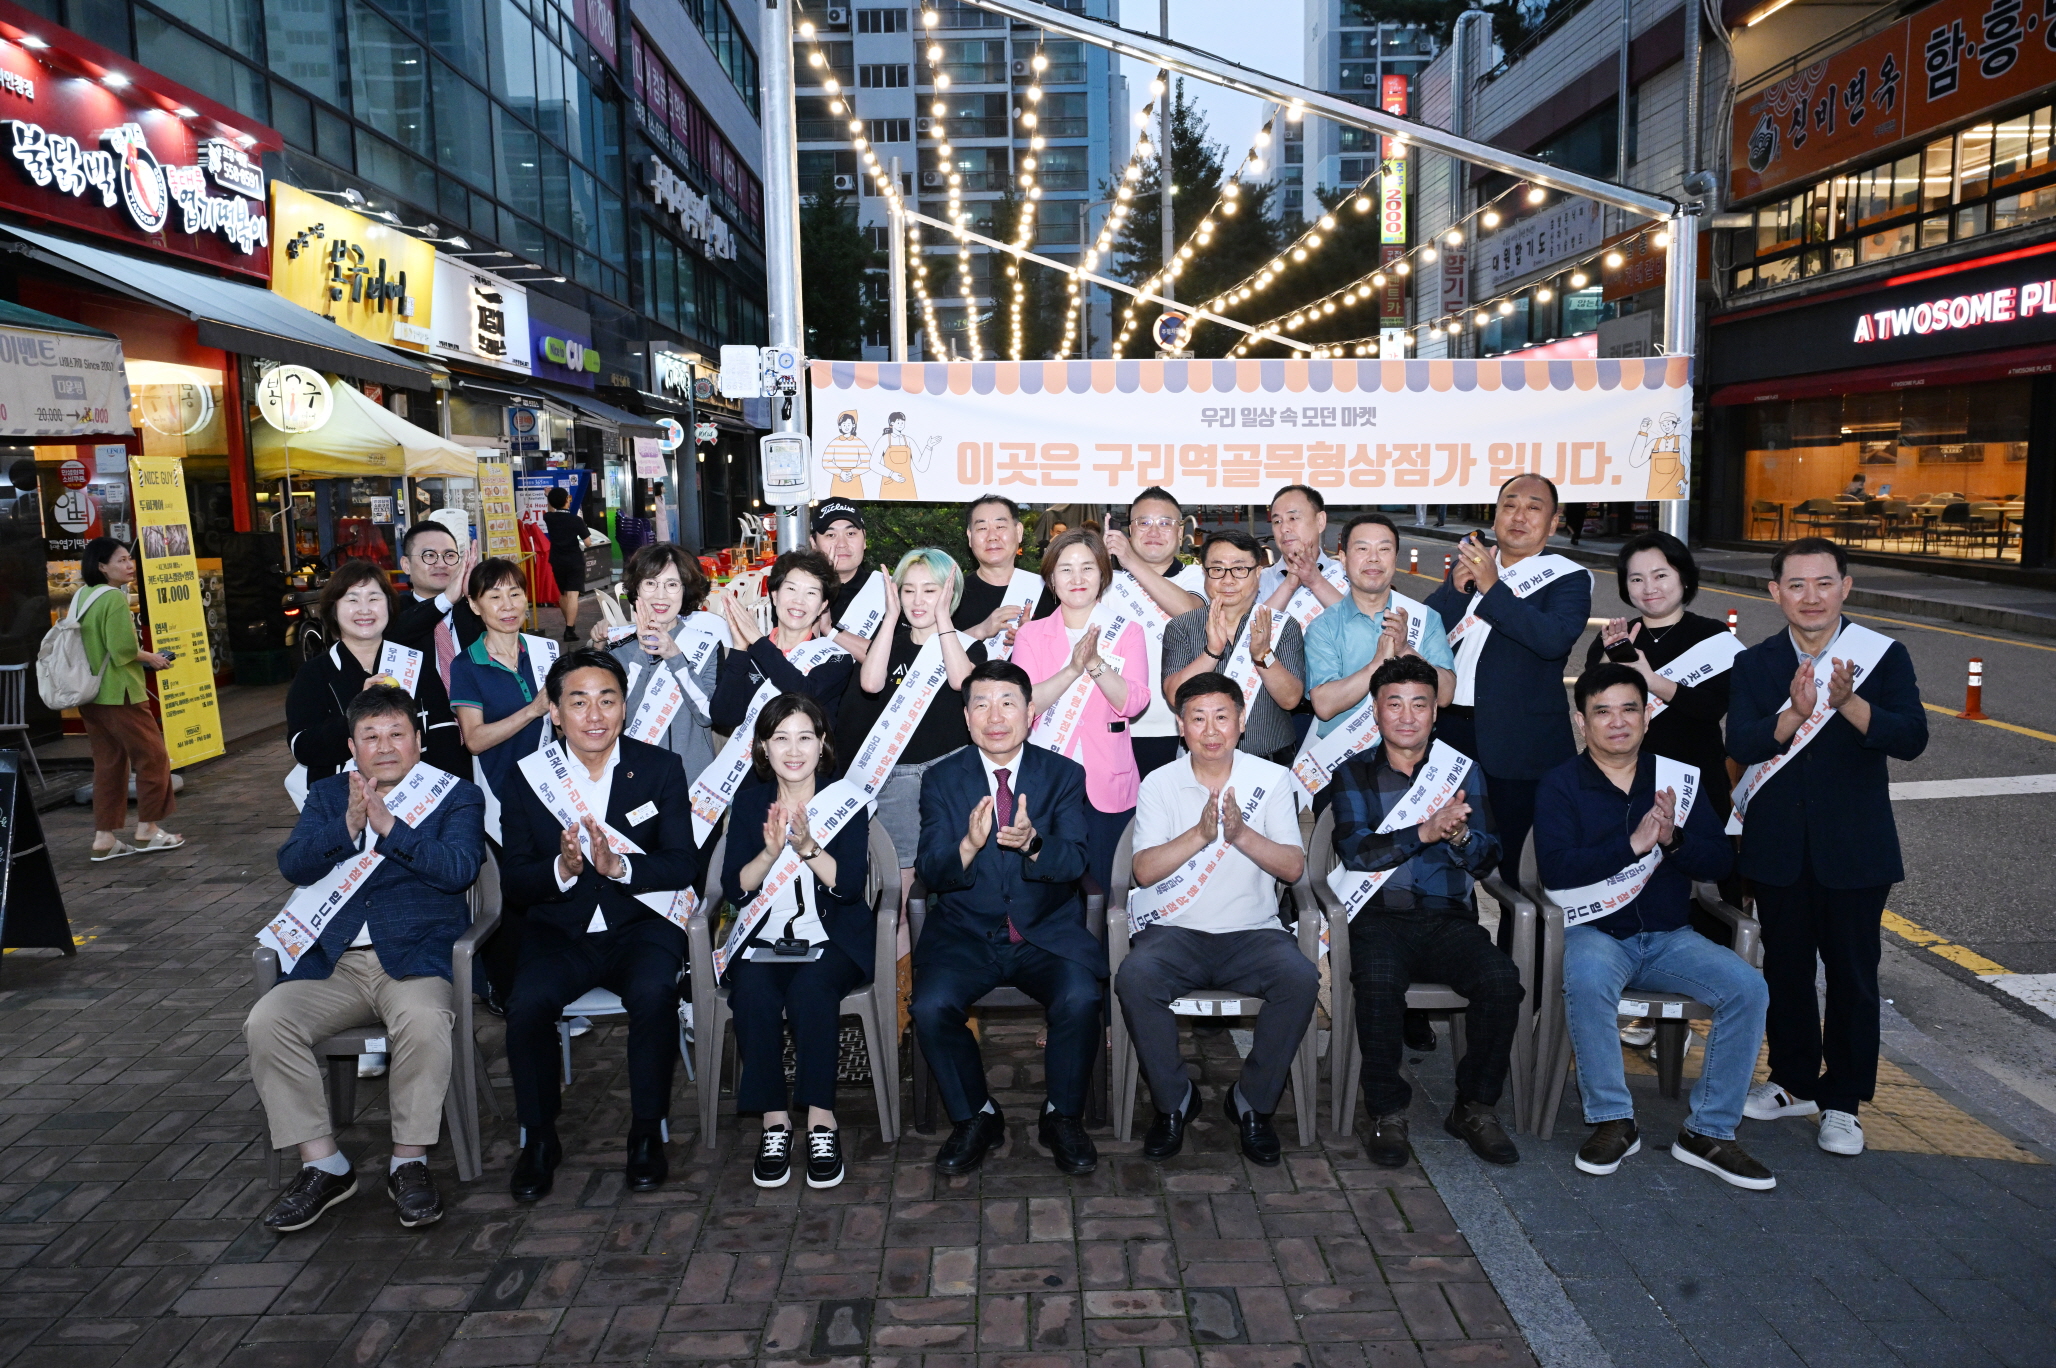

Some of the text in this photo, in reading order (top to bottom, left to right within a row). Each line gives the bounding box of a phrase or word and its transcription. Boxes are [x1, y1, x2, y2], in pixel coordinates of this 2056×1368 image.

[12, 119, 118, 208] 불닭발
[168, 167, 205, 196] 동대문
[179, 188, 268, 255] 엽기떡볶이
[1854, 313, 1873, 343] A
[1873, 288, 2016, 341] TWOSOME
[0, 333, 58, 367] 이벤트
[566, 340, 584, 372] CU
[84, 358, 101, 371] Since
[1200, 406, 1377, 428] 우리 일상 속 모던 마켓
[957, 440, 1622, 488] 이곳은 구리역골목형상점가 입니다.
[144, 471, 173, 485] NICE GUY
[819, 503, 856, 519] Titleist
[1518, 567, 1555, 593] 이곳은
[1130, 600, 1144, 617] 일상
[1104, 615, 1126, 641] 이곳은
[1146, 620, 1155, 629] 속
[387, 647, 397, 662] 우리
[650, 677, 666, 696] 일상
[905, 669, 920, 688] 우리
[760, 692, 768, 702] 속
[890, 694, 905, 713] 일상
[642, 703, 651, 713] 속
[734, 706, 758, 741] 모던마켓
[881, 719, 890, 730] 속
[868, 685, 932, 787] 구리역골목형상점가
[857, 735, 881, 770] 모던마켓
[545, 747, 568, 780] 이곳은
[1425, 765, 1438, 782] 우리
[1446, 756, 1467, 786] 이곳은
[408, 773, 425, 790] 우리
[719, 760, 746, 796] 입니다.
[386, 791, 408, 811] 일상
[539, 782, 555, 803] 우리
[1410, 785, 1427, 805] 일상
[824, 797, 859, 831] 이곳은
[1397, 809, 1408, 821] 속
[1566, 773, 1695, 923] 이곳은 입니다.
[1188, 860, 1197, 870] 속
[1606, 863, 1647, 887] 모던마켓
[1155, 874, 1184, 895] 모던마켓
[310, 890, 343, 931] 입니다.
